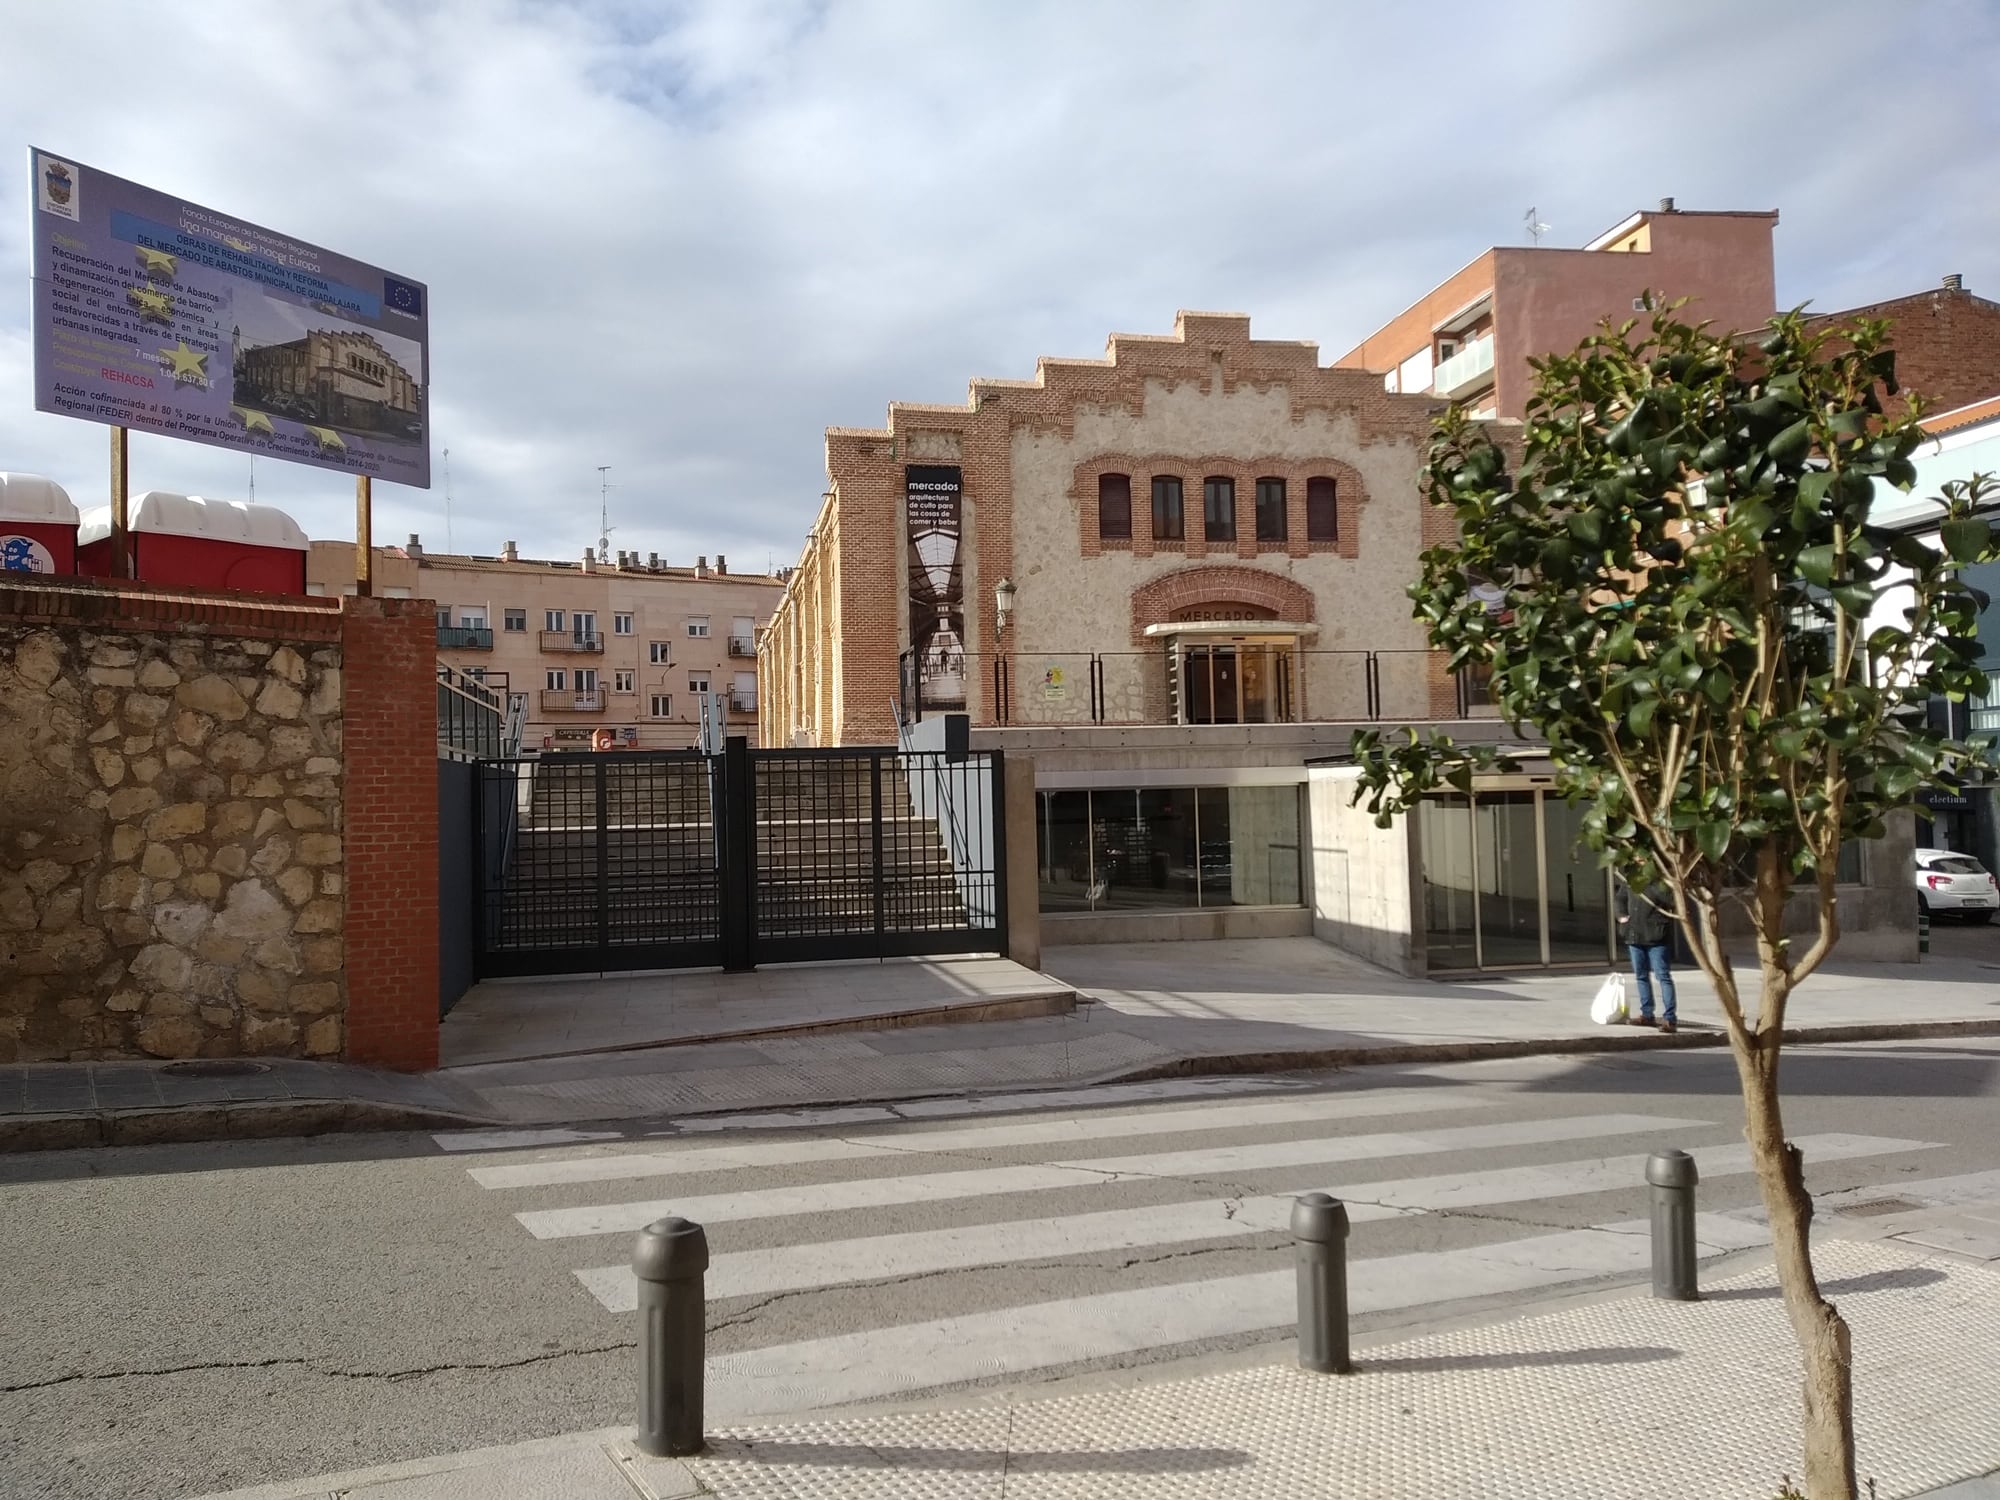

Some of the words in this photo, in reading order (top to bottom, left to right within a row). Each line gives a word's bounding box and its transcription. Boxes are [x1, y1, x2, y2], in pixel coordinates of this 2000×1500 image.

[180, 216, 200, 232] Una
[244, 239, 257, 251] de
[260, 244, 287, 262] hacer
[289, 255, 320, 273] Europa
[182, 206, 207, 221] Fondo
[208, 216, 240, 232] Europeo
[241, 228, 251, 236] de
[52, 246, 115, 273] Recuperación
[117, 265, 132, 276] del
[134, 269, 171, 288] Mercado
[173, 279, 184, 292] de
[186, 285, 220, 302] Abastos
[52, 260, 58, 270] y
[60, 259, 120, 287] dinamización
[121, 280, 135, 291] del
[137, 286, 175, 302] comercio
[177, 295, 187, 306] de
[188, 299, 215, 313] barrio.
[137, 234, 155, 248] DEL
[157, 241, 201, 261] MERCADO
[202, 256, 214, 266] DE
[215, 259, 253, 279] ABASTOS
[254, 273, 295, 293] MUNICIPAL
[296, 286, 307, 297] DE
[308, 289, 361, 312] GUADALAJARA
[176, 234, 206, 252] OBRAS
[208, 244, 220, 255] DE
[221, 249, 284, 277] REHABILITACIÓN
[292, 273, 329, 291] REFORMA
[52, 288, 80, 302] social
[86, 296, 100, 307] del
[106, 304, 141, 319] entorno
[146, 314, 175, 328] urbano
[181, 323, 192, 333] en
[197, 326, 219, 340] áreas
[52, 301, 121, 326] desfavorecidas
[124, 319, 130, 329] a
[133, 321, 159, 337] través
[161, 329, 172, 340] de
[175, 334, 220, 352] Estrategias
[53, 273, 115, 299] Regeneración
[161, 305, 205, 324] económica
[214, 320, 219, 329] y
[52, 315, 90, 332] urbanas
[92, 325, 141, 345] integradas.
[101, 368, 155, 389] REHACSA
[135, 348, 140, 359] 7
[142, 351, 170, 365] meses
[53, 382, 86, 397] Acción
[90, 391, 146, 411] cofinanciada
[150, 402, 158, 413] al
[161, 405, 171, 416] 80
[175, 408, 183, 418] %
[186, 412, 200, 422] por
[204, 415, 211, 424] la
[214, 417, 237, 430] Unión
[273, 431, 287, 441] con
[290, 435, 310, 447] cargo
[346, 446, 375, 460] Europeo
[54, 397, 95, 413] Regional
[97, 406, 134, 423] (FEDER)
[136, 413, 163, 428] dentro
[164, 420, 178, 431] del
[180, 422, 217, 437] Programa
[219, 431, 255, 447] Operativo
[256, 439, 266, 449] de
[267, 441, 310, 457] Crecimiento
[908, 482, 959, 491] mercados
[908, 494, 950, 502] arquitectura
[938, 518, 958, 526] beber
[1180, 610, 1256, 621] MERCADO
[1929, 794, 1968, 804] electium
